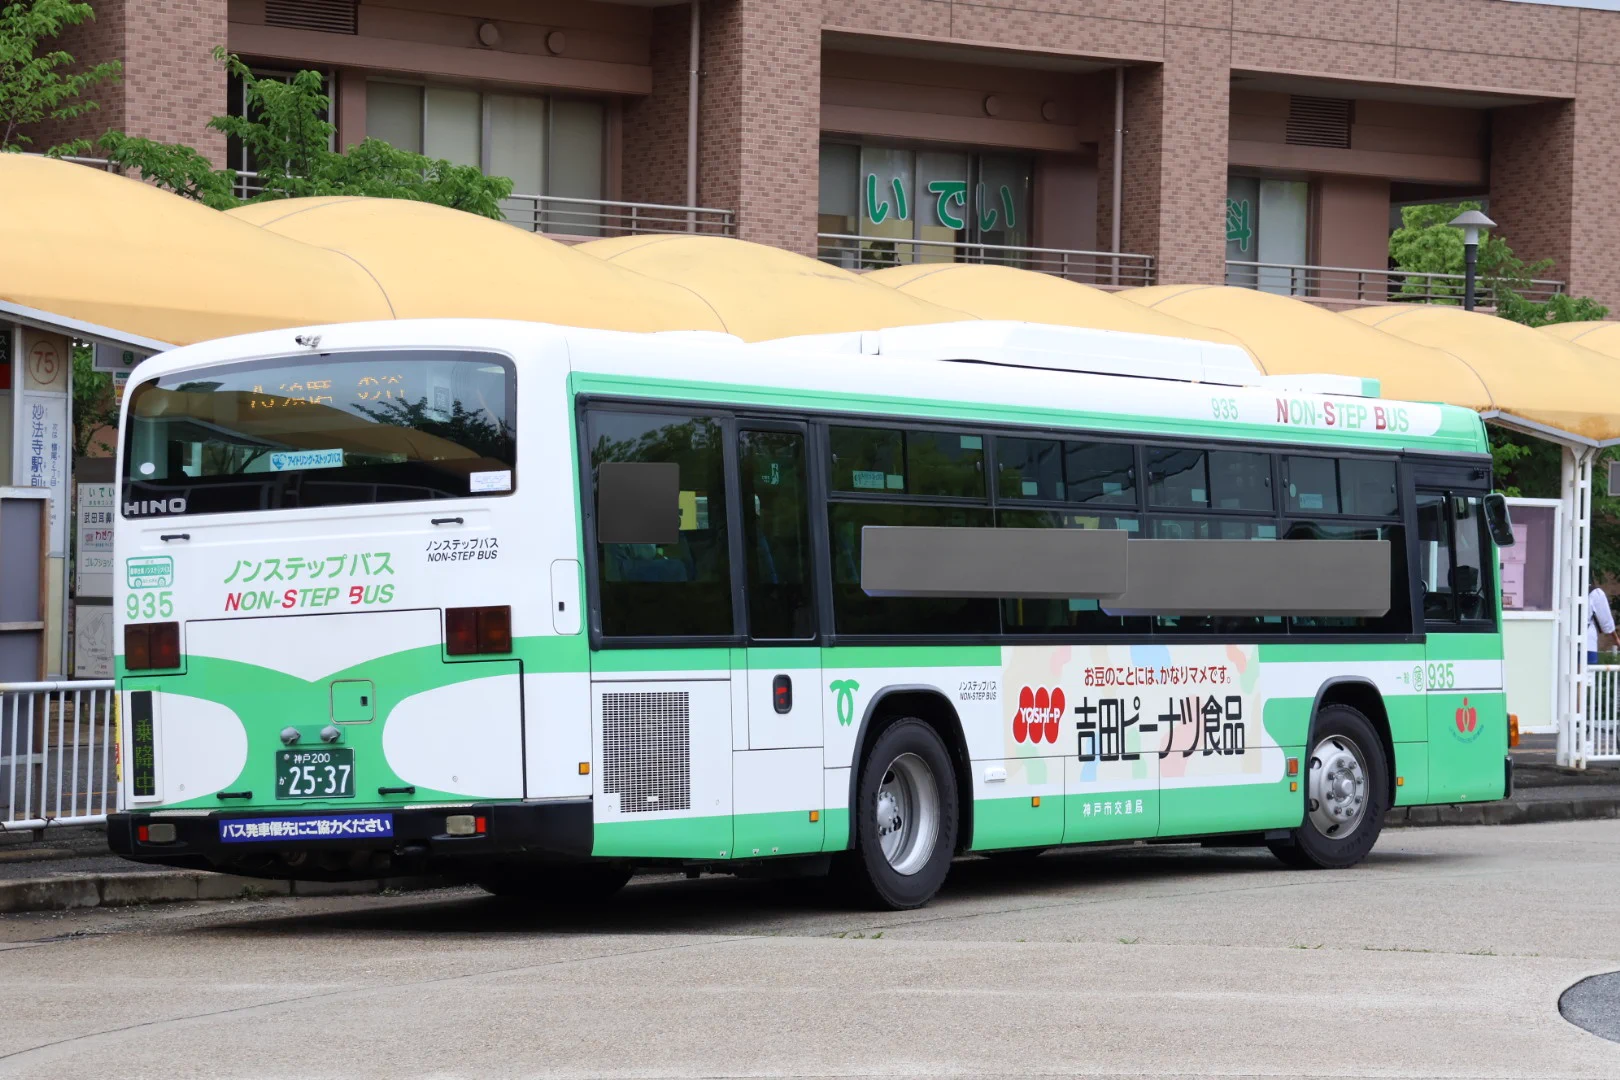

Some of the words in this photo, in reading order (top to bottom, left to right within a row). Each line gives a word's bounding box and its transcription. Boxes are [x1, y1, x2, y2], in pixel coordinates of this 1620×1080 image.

[34, 351, 56, 374] 75
[1211, 398, 1239, 420] 935
[1276, 398, 1367, 429] NON-STEP
[1374, 406, 1409, 432] BUS
[31, 403, 44, 487] 妙法寺駅前
[124, 498, 186, 515] HINO
[84, 512, 114, 524] 武田耳鼻
[426, 537, 498, 551] ノンステップバス
[428, 551, 475, 562] NON-STEP
[477, 550, 498, 560] BUS
[224, 552, 395, 584] ノンステップバス
[126, 591, 173, 620] 935
[224, 587, 340, 612] NON-STEP
[349, 584, 395, 605] BUS
[958, 680, 997, 691] ノンステップバス
[1084, 666, 1231, 687] お豆のことには、かなりマメです。
[1428, 663, 1454, 688] 935
[960, 692, 985, 701] NON-STEP
[986, 691, 997, 700] BUS
[1074, 695, 1245, 762] 吉田ピーナツ食品
[136, 719, 154, 795] 乗降中
[289, 765, 351, 795] 25-37
[1083, 799, 1143, 817] 神戸市交通局
[223, 818, 391, 838] バス発車優先にご協力ください
